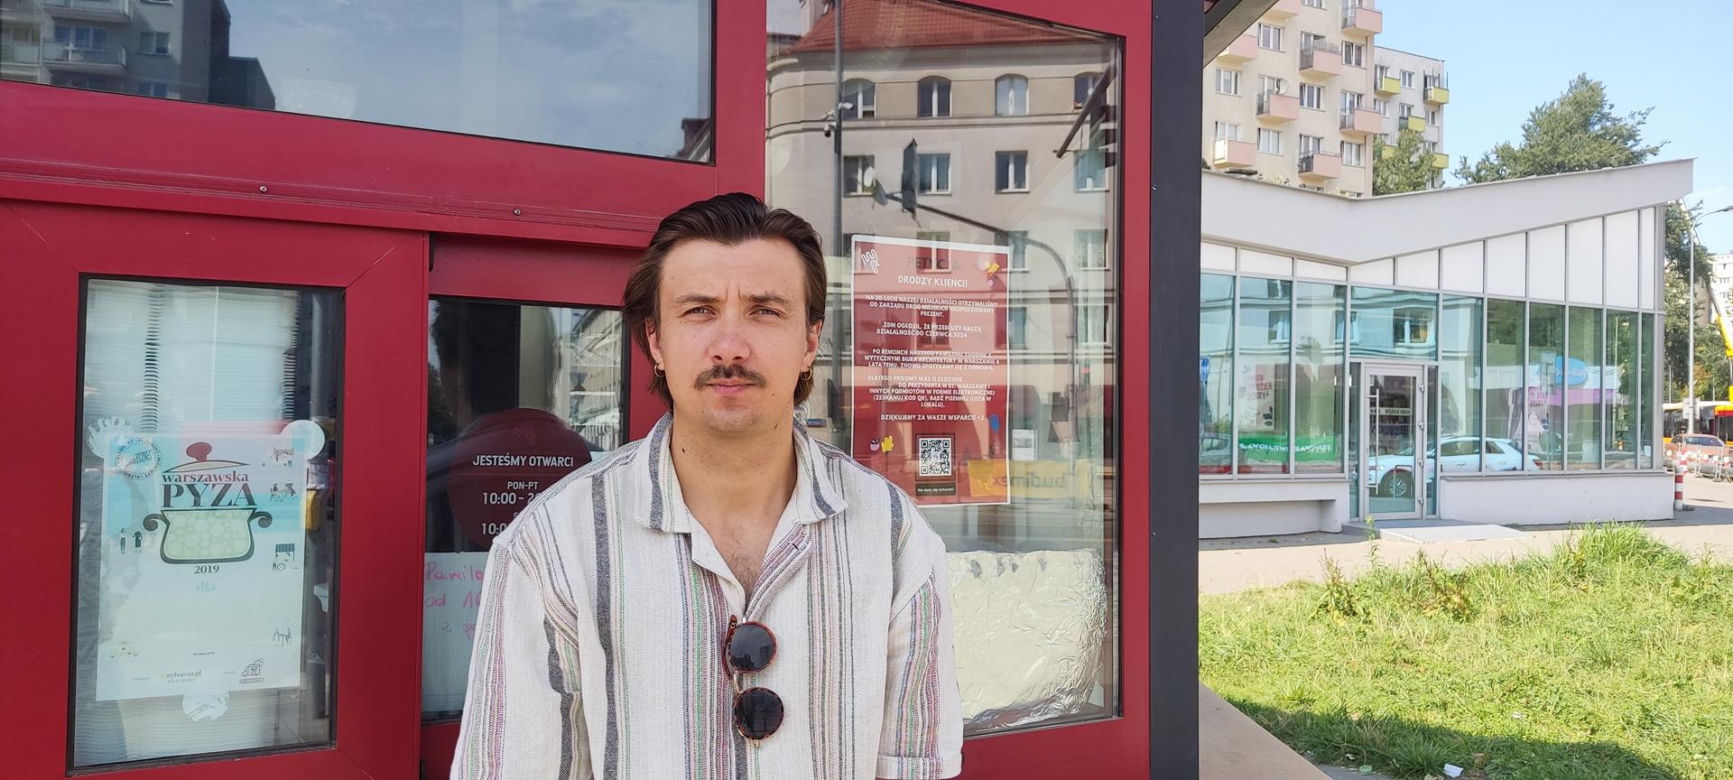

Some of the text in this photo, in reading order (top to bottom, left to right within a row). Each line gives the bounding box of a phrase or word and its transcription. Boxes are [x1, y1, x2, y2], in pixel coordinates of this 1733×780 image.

[897, 275, 931, 286] DRODZY
[472, 452, 574, 467] JESTEŚMY OTWARCI
[162, 470, 249, 483] warszawska
[507, 481, 539, 490] PON-PT
[160, 483, 257, 507] PYZA
[482, 492, 517, 505] 10:00
[194, 564, 220, 574] 2019
[426, 561, 484, 581] Pawilo
